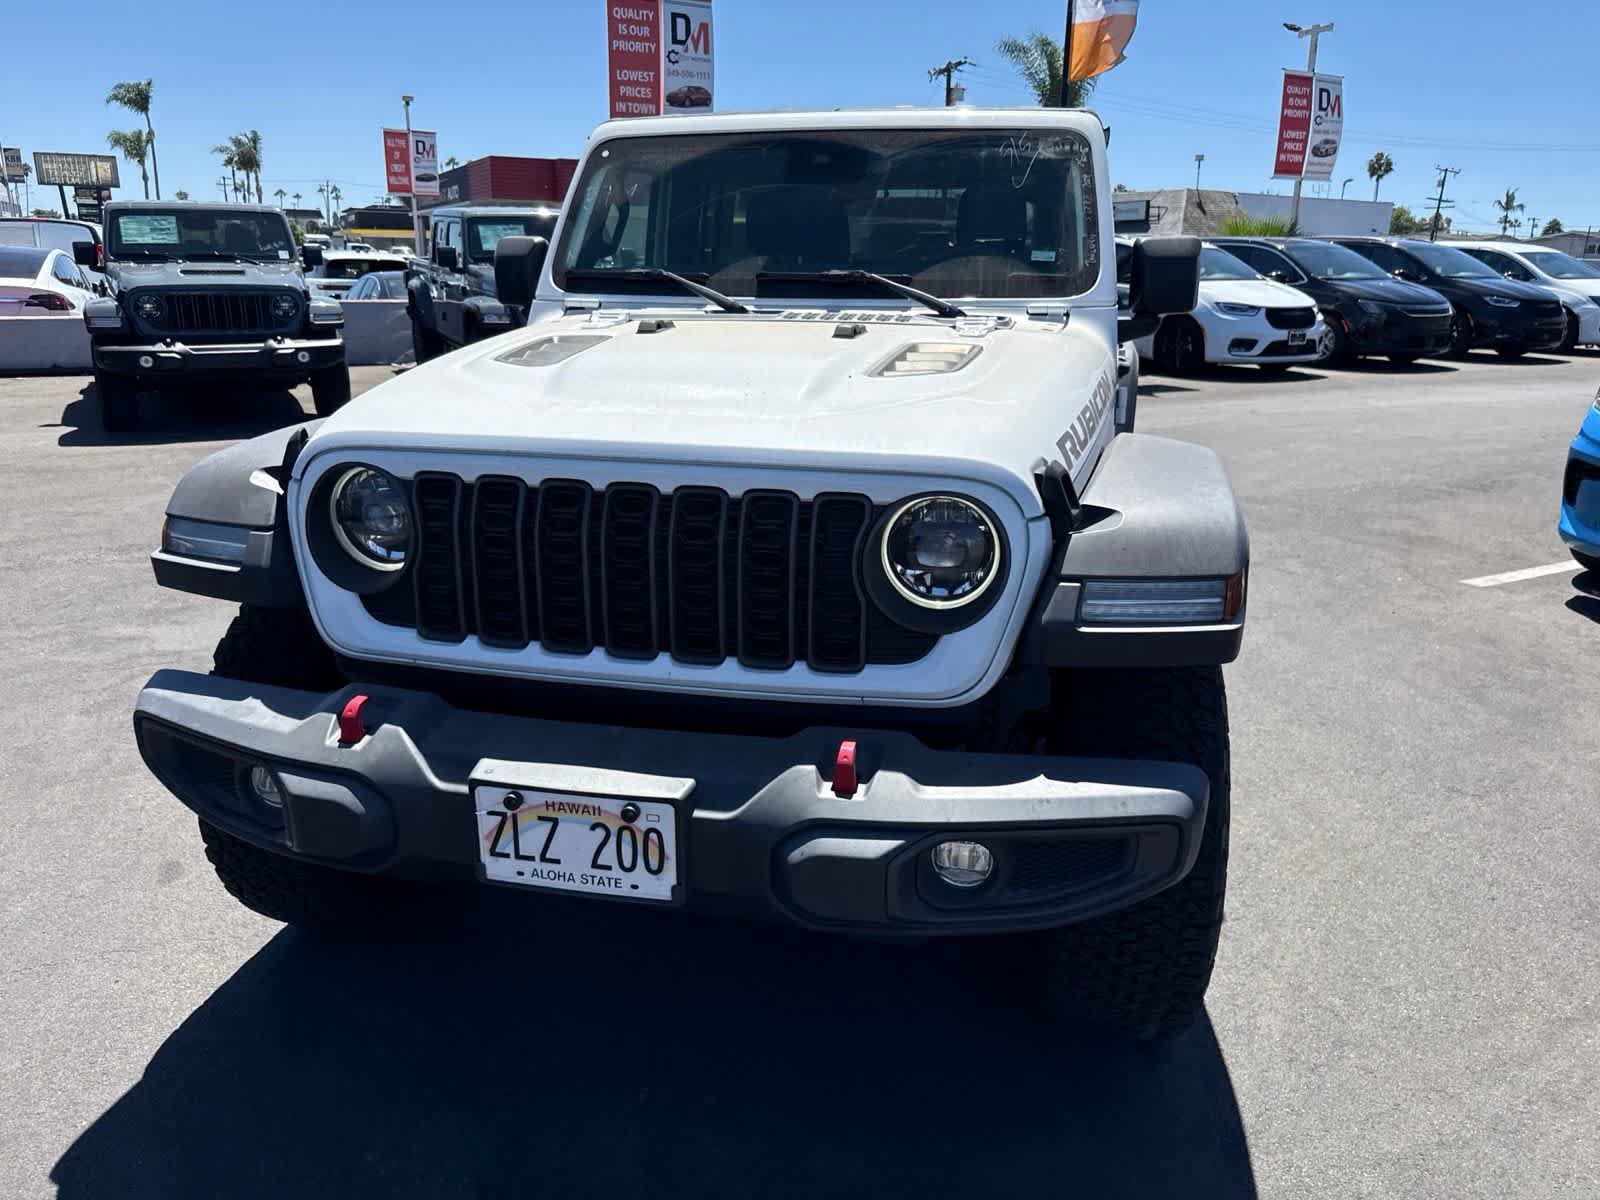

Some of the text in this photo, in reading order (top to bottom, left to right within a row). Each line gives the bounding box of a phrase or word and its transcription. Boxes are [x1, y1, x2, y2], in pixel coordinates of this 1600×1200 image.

[613, 7, 654, 20] QUALITY
[618, 24, 650, 37] IS OUR
[670, 12, 710, 55] DM
[612, 40, 656, 54] PRIORITY
[616, 70, 655, 82] LOWEST
[620, 85, 652, 98] PRICES
[1286, 85, 1310, 95] QUALITY
[616, 102, 656, 114] IN TOWN
[1294, 98, 1307, 106] OUR
[1318, 87, 1341, 118] DM
[1283, 110, 1309, 119] PRIORITY
[1283, 130, 1306, 140] LOWEST
[1283, 142, 1303, 151] PRICES
[1286, 154, 1304, 163] TOWN
[1056, 370, 1112, 471] RUBICON
[545, 800, 601, 817] HAWAII
[486, 810, 665, 876] ZLZ 200
[531, 868, 622, 889] ALOHA STATE
